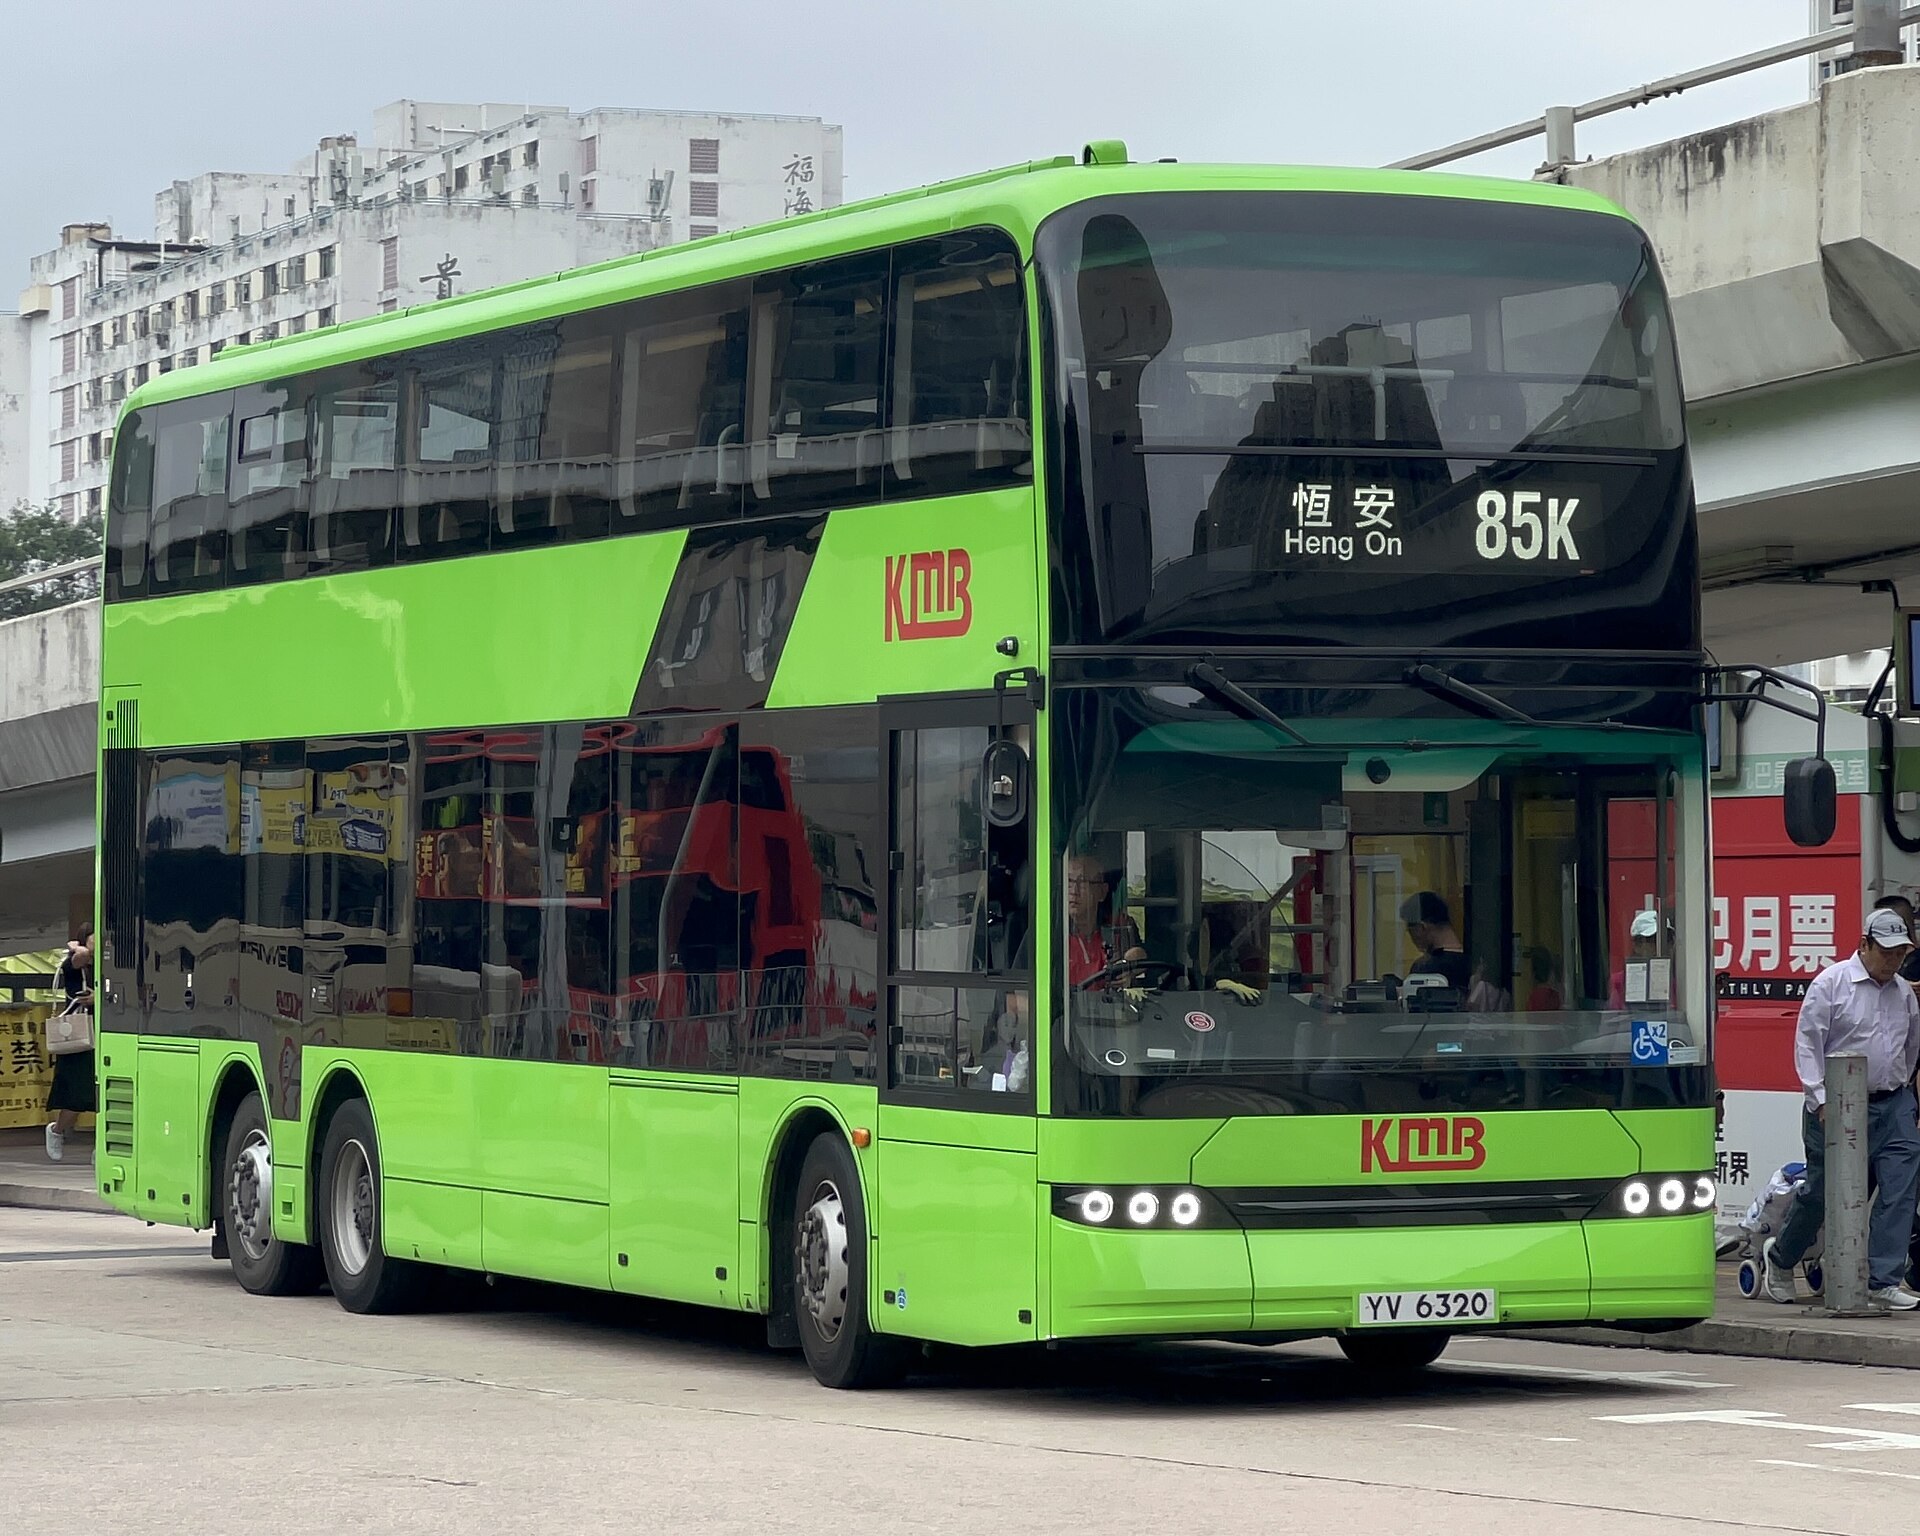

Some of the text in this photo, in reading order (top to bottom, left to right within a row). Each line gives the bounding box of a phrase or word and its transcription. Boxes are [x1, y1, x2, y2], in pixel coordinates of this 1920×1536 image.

[1285, 529, 1402, 560] Heng On
[1476, 490, 1580, 560] 85K
[884, 548, 972, 642] KMB
[1652, 1024, 1666, 1038] x2
[1361, 1117, 1487, 1173] KMB
[1367, 1292, 1488, 1321] YV 6320
